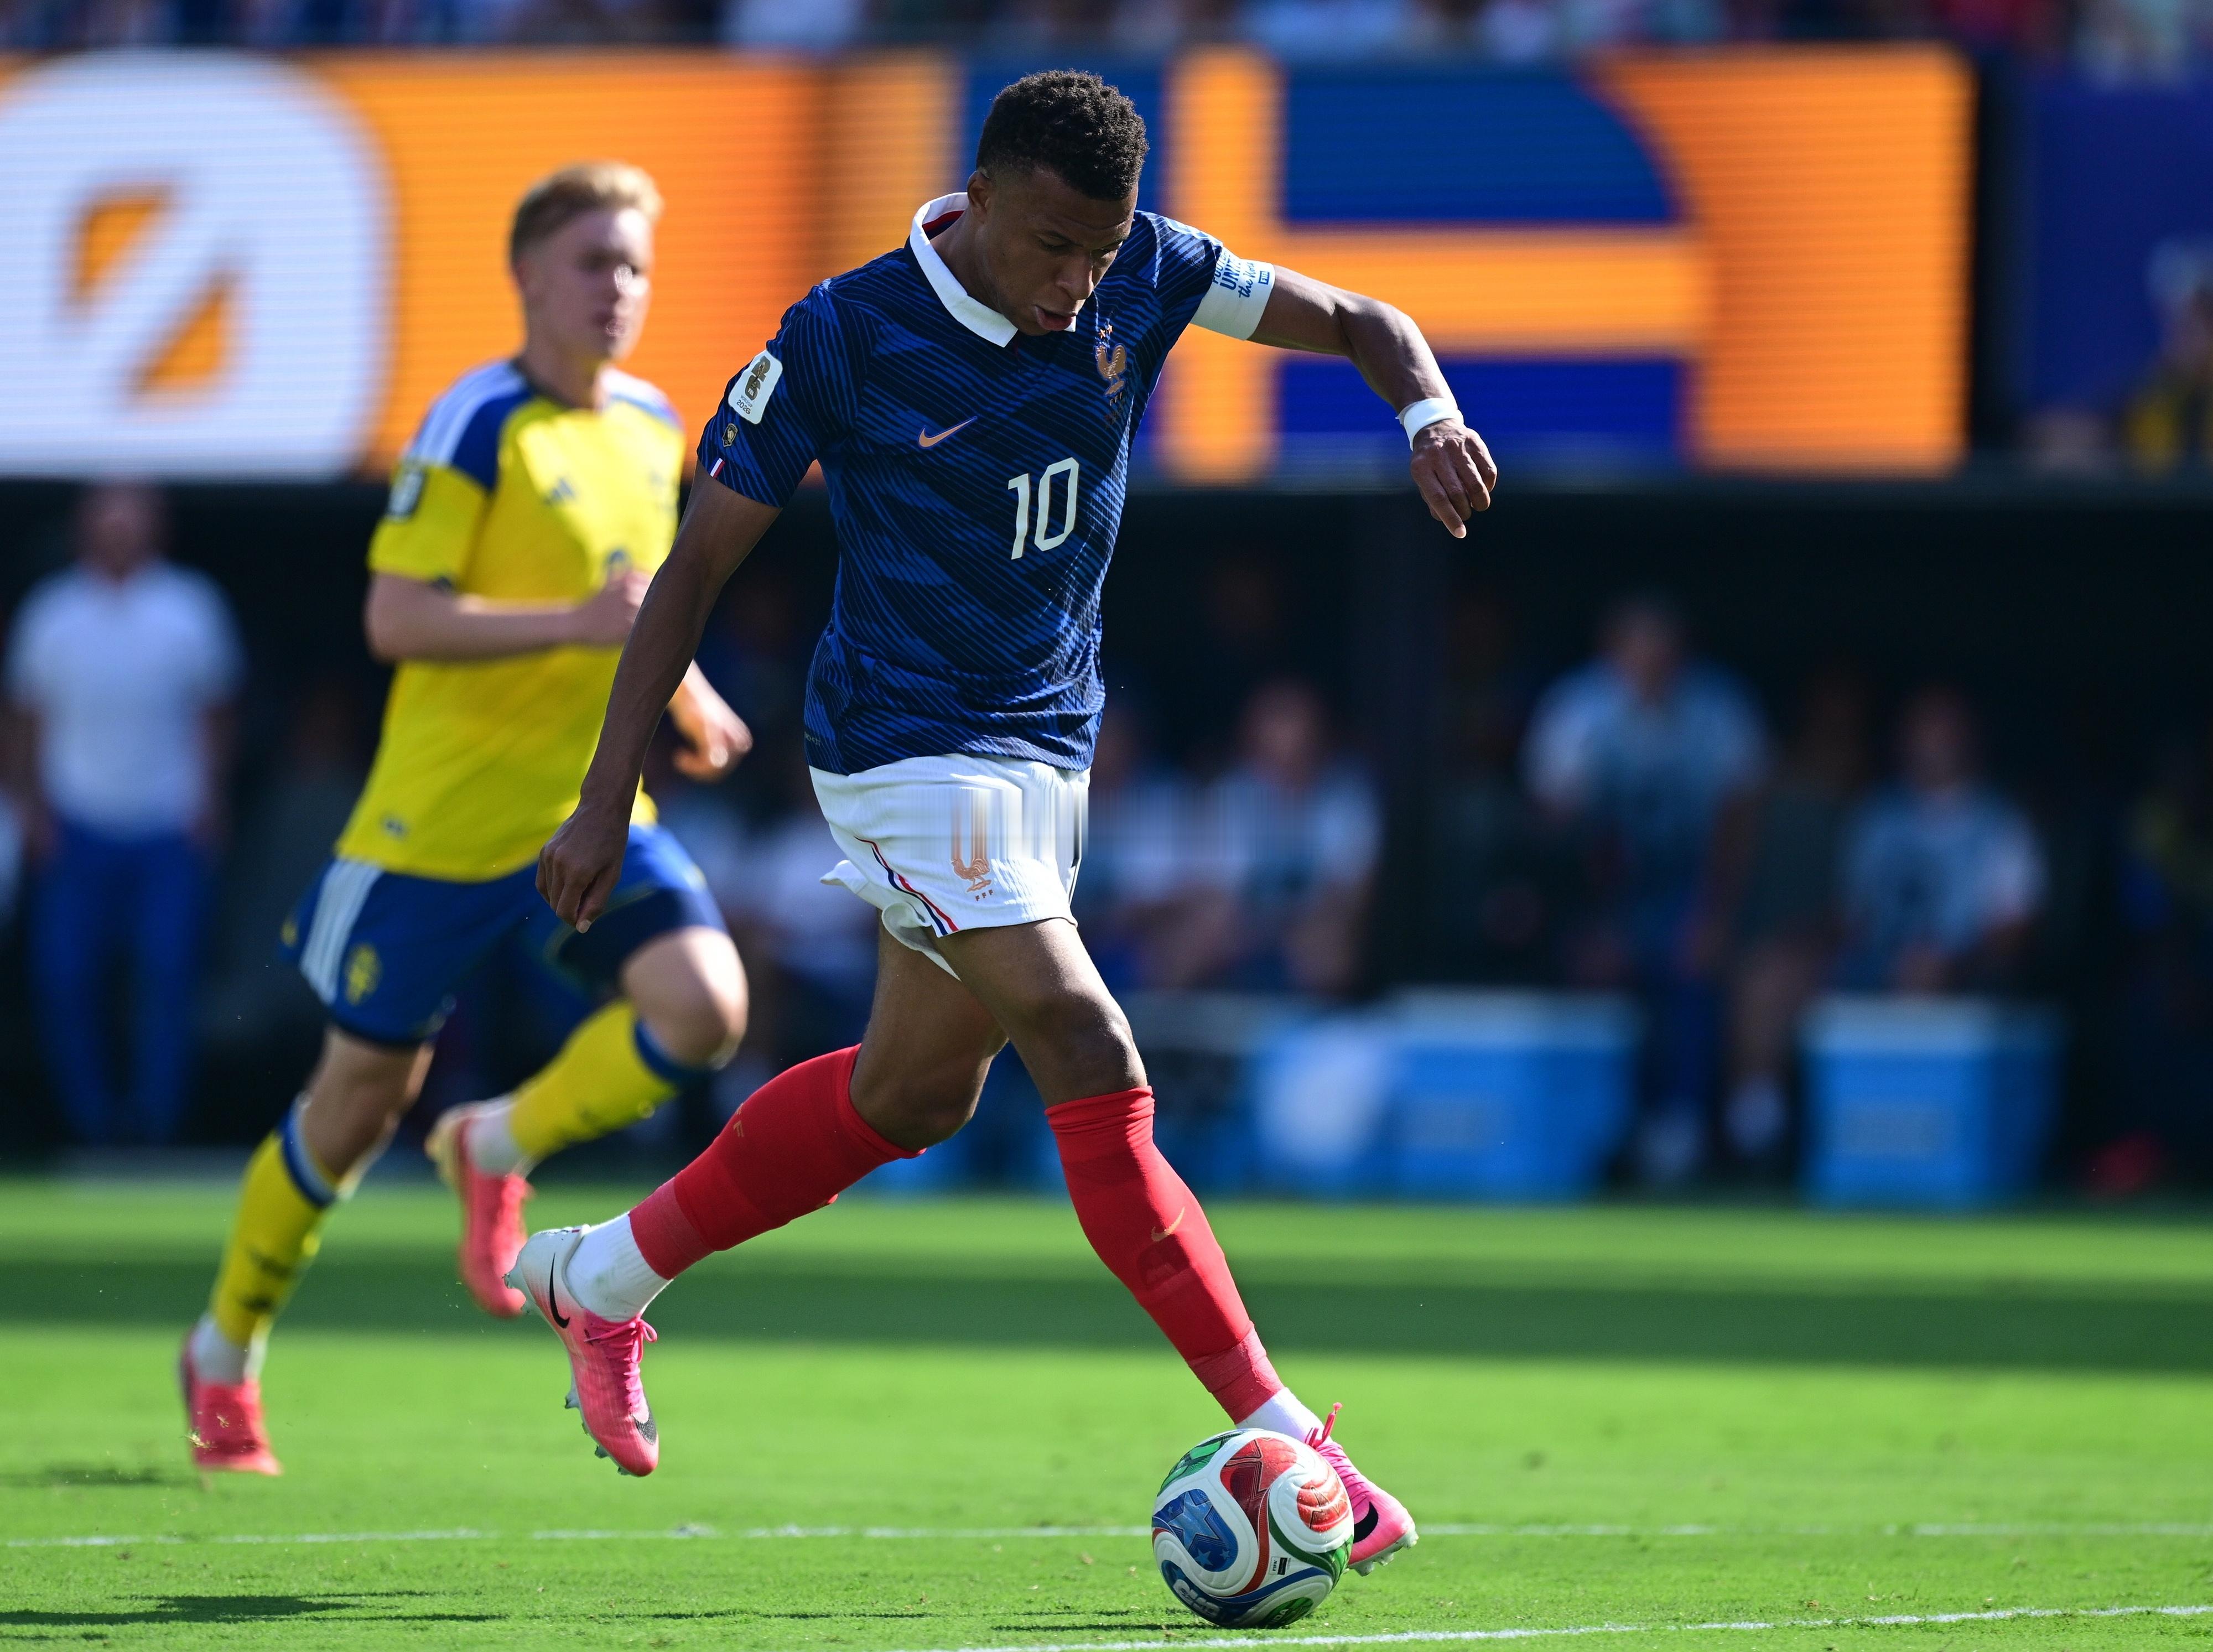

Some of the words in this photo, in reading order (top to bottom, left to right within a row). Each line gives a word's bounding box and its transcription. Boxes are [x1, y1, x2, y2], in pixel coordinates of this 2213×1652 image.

[1238, 279, 1253, 298] the
[736, 399, 751, 414] 2026
[1007, 457, 1079, 560] 10
